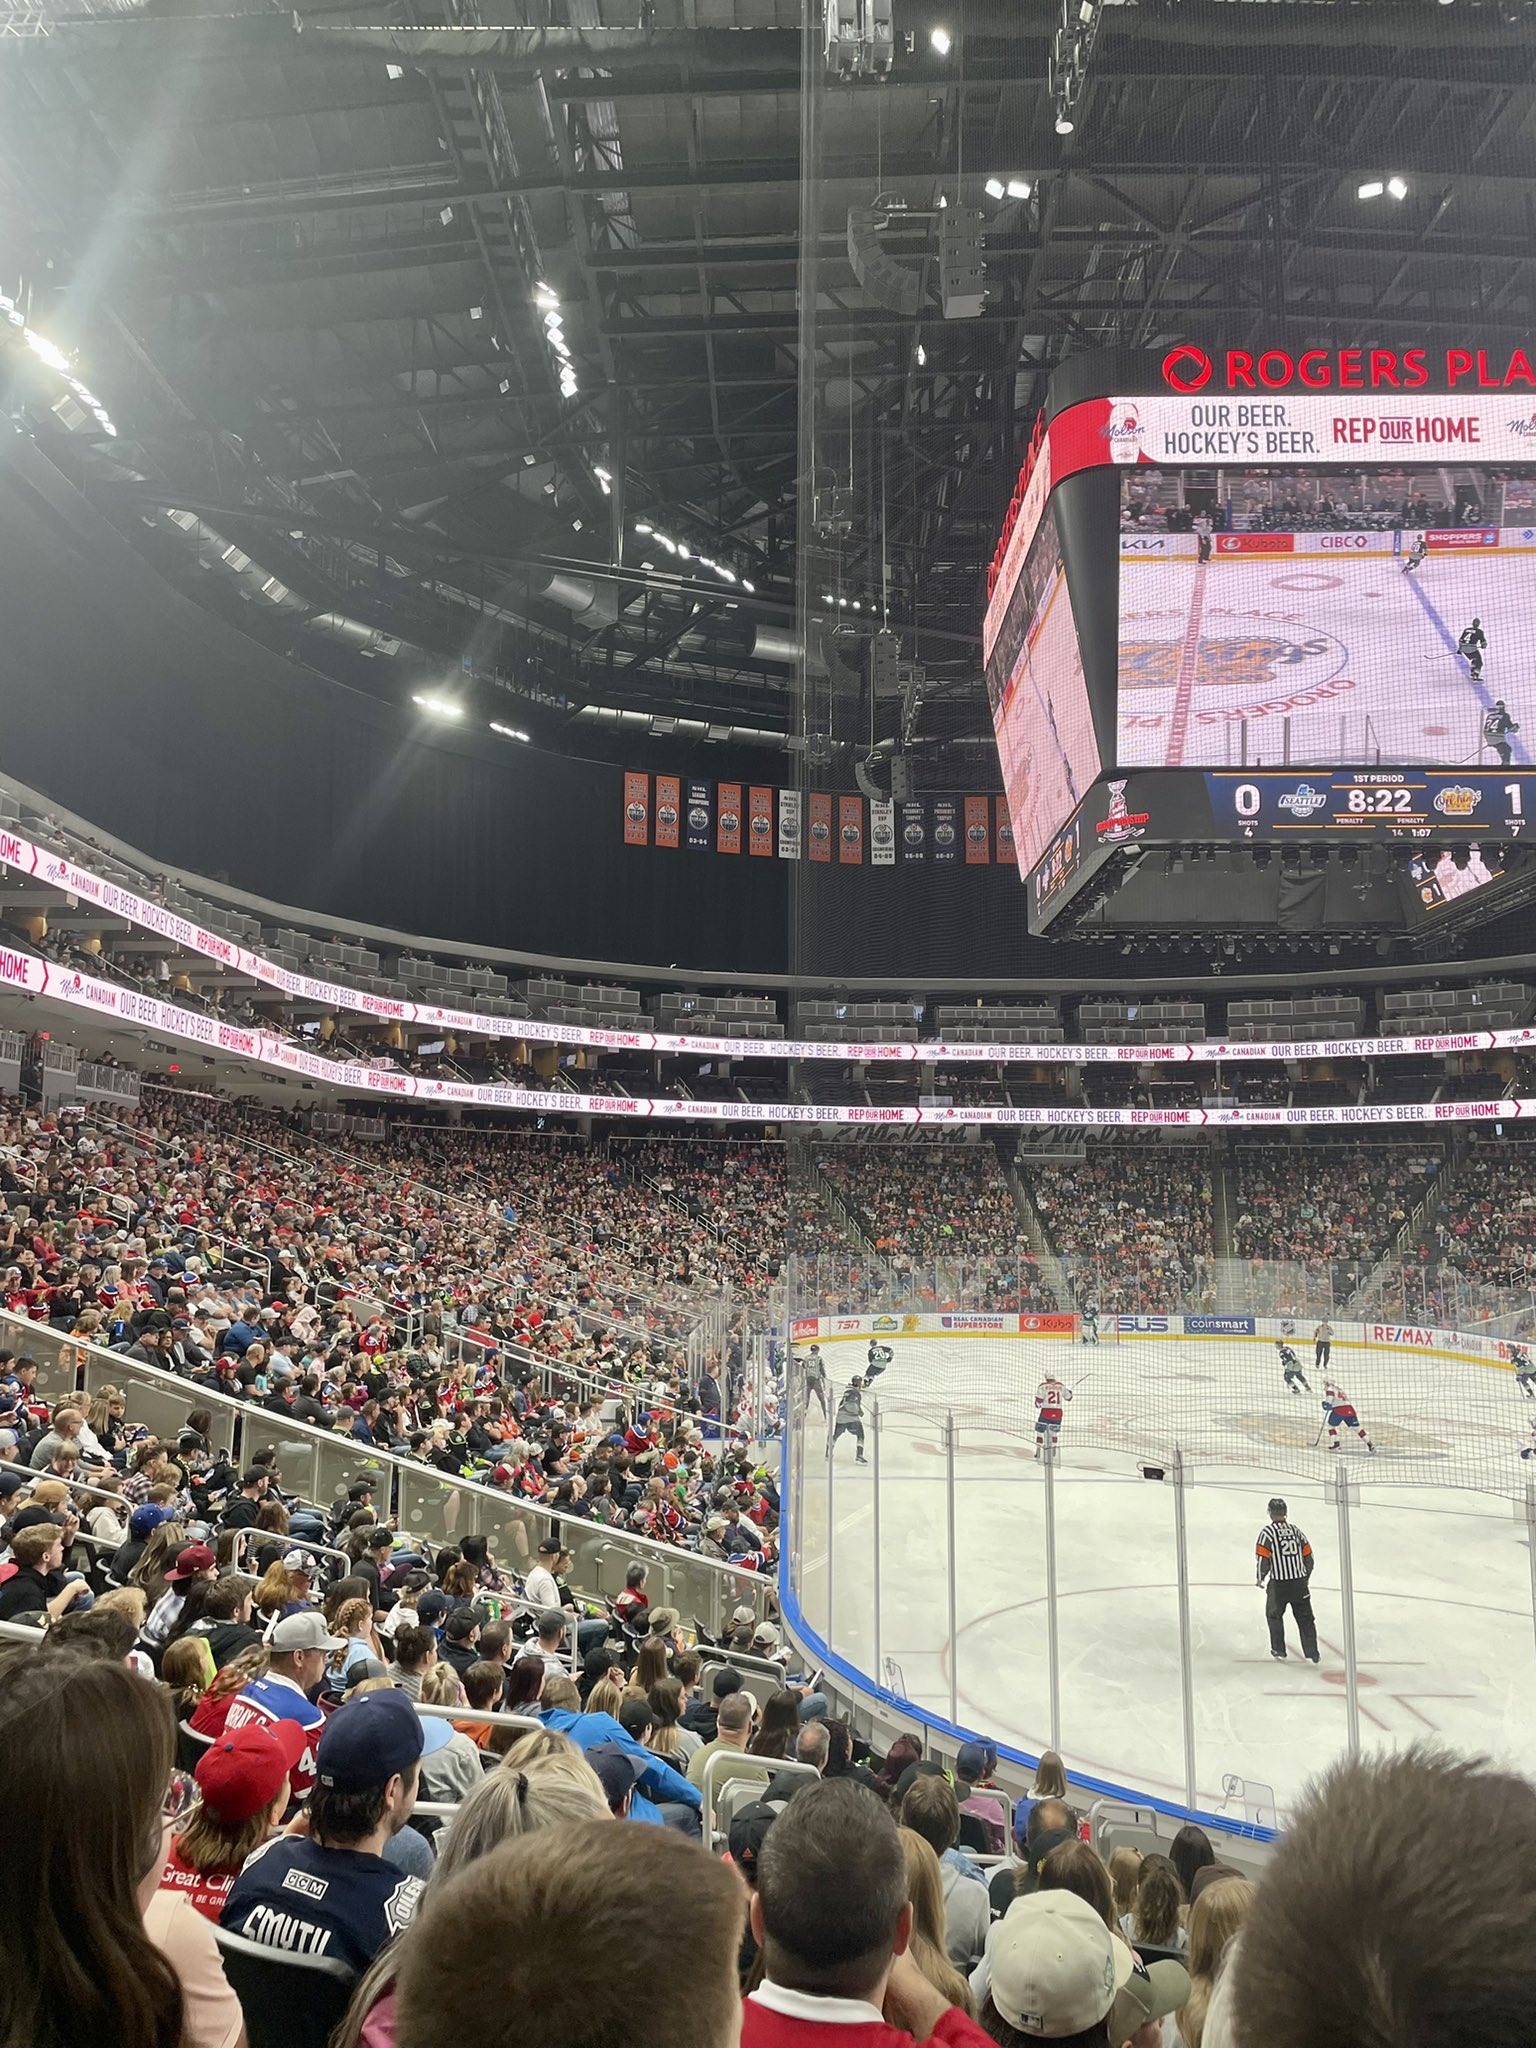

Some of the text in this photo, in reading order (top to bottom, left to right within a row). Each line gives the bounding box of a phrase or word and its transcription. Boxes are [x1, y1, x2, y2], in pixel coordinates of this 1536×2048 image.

[1226, 349, 1536, 388] ROGERS PLA
[1192, 405, 1292, 427] OUR BEER.
[1333, 417, 1480, 443] REP OUR HOME
[1165, 432, 1320, 454] HOCKEY'S BEER.
[1321, 536, 1352, 548] CIBC
[1353, 775, 1405, 783] 1ST PERIOD
[1234, 784, 1261, 815] 0
[1282, 796, 1323, 806] SEATTLE
[1348, 789, 1412, 813] 8:22
[1504, 783, 1522, 815] 1
[1244, 827, 1254, 837] 4
[1411, 828, 1432, 837] 1:07
[1511, 826, 1520, 837] 7
[71, 872, 100, 898] CANADIAN
[103, 885, 119, 911] OUR
[120, 893, 140, 919] BEER.
[142, 902, 175, 936] HOCKEY'S
[176, 920, 193, 945] BEER.
[197, 930, 208, 949] REP
[216, 938, 231, 960] HOME
[305, 980, 338, 1002] HOCKEY'S
[340, 991, 357, 1007] BEER.
[362, 996, 374, 1011] REP
[383, 1000, 405, 1017] HOME
[86, 984, 116, 1008] CANADIAN
[120, 993, 136, 1018] OUR
[138, 1000, 158, 1024] BEER.
[161, 1006, 195, 1036] HOCKEY'S
[196, 1018, 214, 1040] BEER.
[219, 1026, 230, 1046] REP
[239, 1035, 253, 1054] HOME
[447, 1012, 473, 1026] CANADIAN
[476, 1016, 490, 1030] OUR
[492, 1019, 515, 1034] BEER.
[518, 1023, 559, 1039] HOCKEY'S
[561, 1028, 584, 1041] BEER.
[589, 1031, 604, 1043] REP
[617, 1034, 640, 1046] HOME
[691, 1041, 902, 1057] CANADIAN OUR BEER. HOCKEY'S BEER. REP HOME
[952, 1048, 983, 1056] CANADIAN
[988, 1047, 1007, 1059] OUR
[1010, 1047, 1034, 1059] BEER.
[1037, 1047, 1082, 1059] HOCKEY'S
[1084, 1047, 1111, 1059] BEER.
[1117, 1048, 1135, 1059] REP
[1149, 1048, 1175, 1059] HOME
[1232, 1035, 1478, 1057] CANADIAN OUR BEER. HOCKEY'S BEER. REP OUR HOME
[344, 1069, 363, 1085] BEER.
[368, 1072, 380, 1087] REP
[390, 1076, 406, 1092] HOME
[447, 1086, 473, 1098] CANADIAN
[478, 1087, 493, 1101] OUR
[495, 1090, 513, 1103] BEER.
[516, 1092, 557, 1107] HOCKEY'S
[560, 1096, 582, 1109] BEER.
[589, 1098, 604, 1110] REP
[617, 1100, 638, 1112] HOME
[688, 1106, 717, 1114] CANADIAN
[722, 1105, 739, 1117] OUR
[742, 1106, 765, 1118] BEER.
[769, 1106, 813, 1119] HOCKEY'S
[817, 1107, 841, 1120] BEER.
[849, 1109, 865, 1120] REP
[880, 1109, 904, 1120] HOME
[960, 1111, 992, 1120] CANADIAN
[997, 1110, 1016, 1121] OUR
[1019, 1110, 1044, 1122] BEER.
[1048, 1110, 1094, 1122] HOCKEY'S
[1097, 1111, 1124, 1123] BEER.
[1131, 1112, 1149, 1123] REP
[1164, 1111, 1190, 1123] HOME
[1246, 1112, 1281, 1121] CANADIAN
[1287, 1110, 1308, 1122] OUR
[1310, 1109, 1338, 1121] BEER.
[1342, 1107, 1393, 1121] HOCKEY'S
[1396, 1107, 1427, 1120] BEER.
[1435, 1105, 1454, 1118] REP
[1471, 1103, 1500, 1117] HOME
[837, 1319, 860, 1330] TSN
[1101, 1317, 1168, 1332] ASUS
[1191, 1318, 1249, 1329] coinsmart
[1374, 1326, 1433, 1346] RE/MAX
[873, 1348, 885, 1360] 20
[1047, 1391, 1061, 1405] 21
[1281, 1540, 1298, 1556] 20
[161, 1863, 201, 1888] Great
[286, 1872, 325, 1896] CCM
